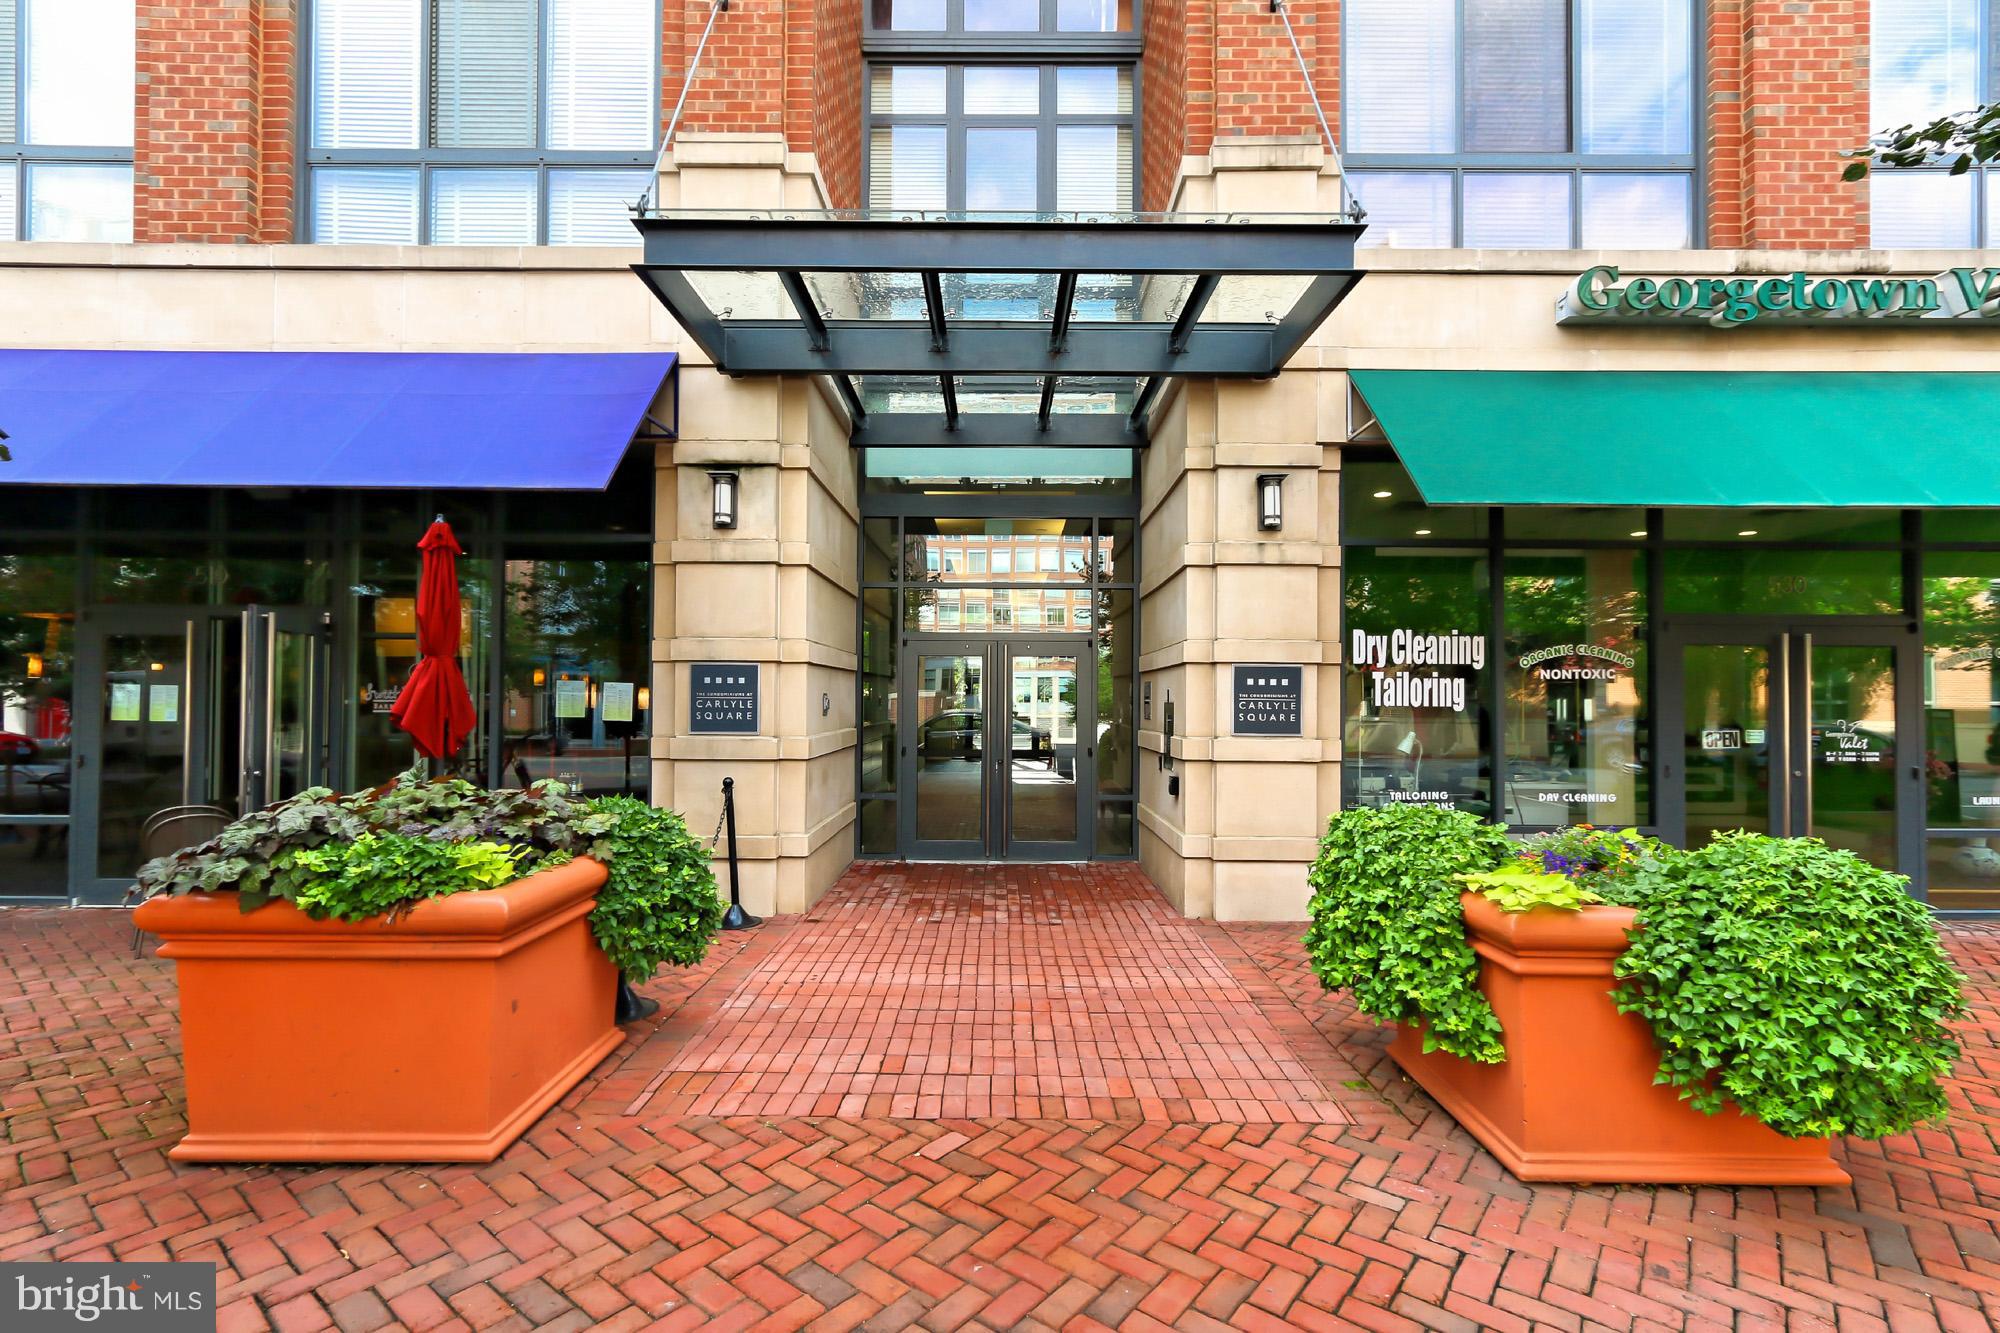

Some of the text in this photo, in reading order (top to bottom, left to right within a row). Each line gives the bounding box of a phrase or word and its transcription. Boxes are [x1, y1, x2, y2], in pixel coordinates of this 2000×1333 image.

[1577, 265, 1940, 323] Georgetown
[1352, 628, 1485, 670] Dry Cleaning
[1519, 644, 1635, 668] ORGANIC CLEANING
[1540, 668, 1616, 680] NONTOXIC
[1371, 671, 1465, 712] Tailoring
[696, 700, 753, 709] CARLYLE
[1238, 701, 1296, 710] CARLYLE
[696, 711, 753, 720] SQUARE
[1238, 713, 1296, 722] SQUARE
[1705, 731, 1739, 748] OPEN
[1839, 736, 1869, 750] Valet
[1389, 791, 1449, 801] TAILORING
[1562, 792, 1617, 803] CLEANING
